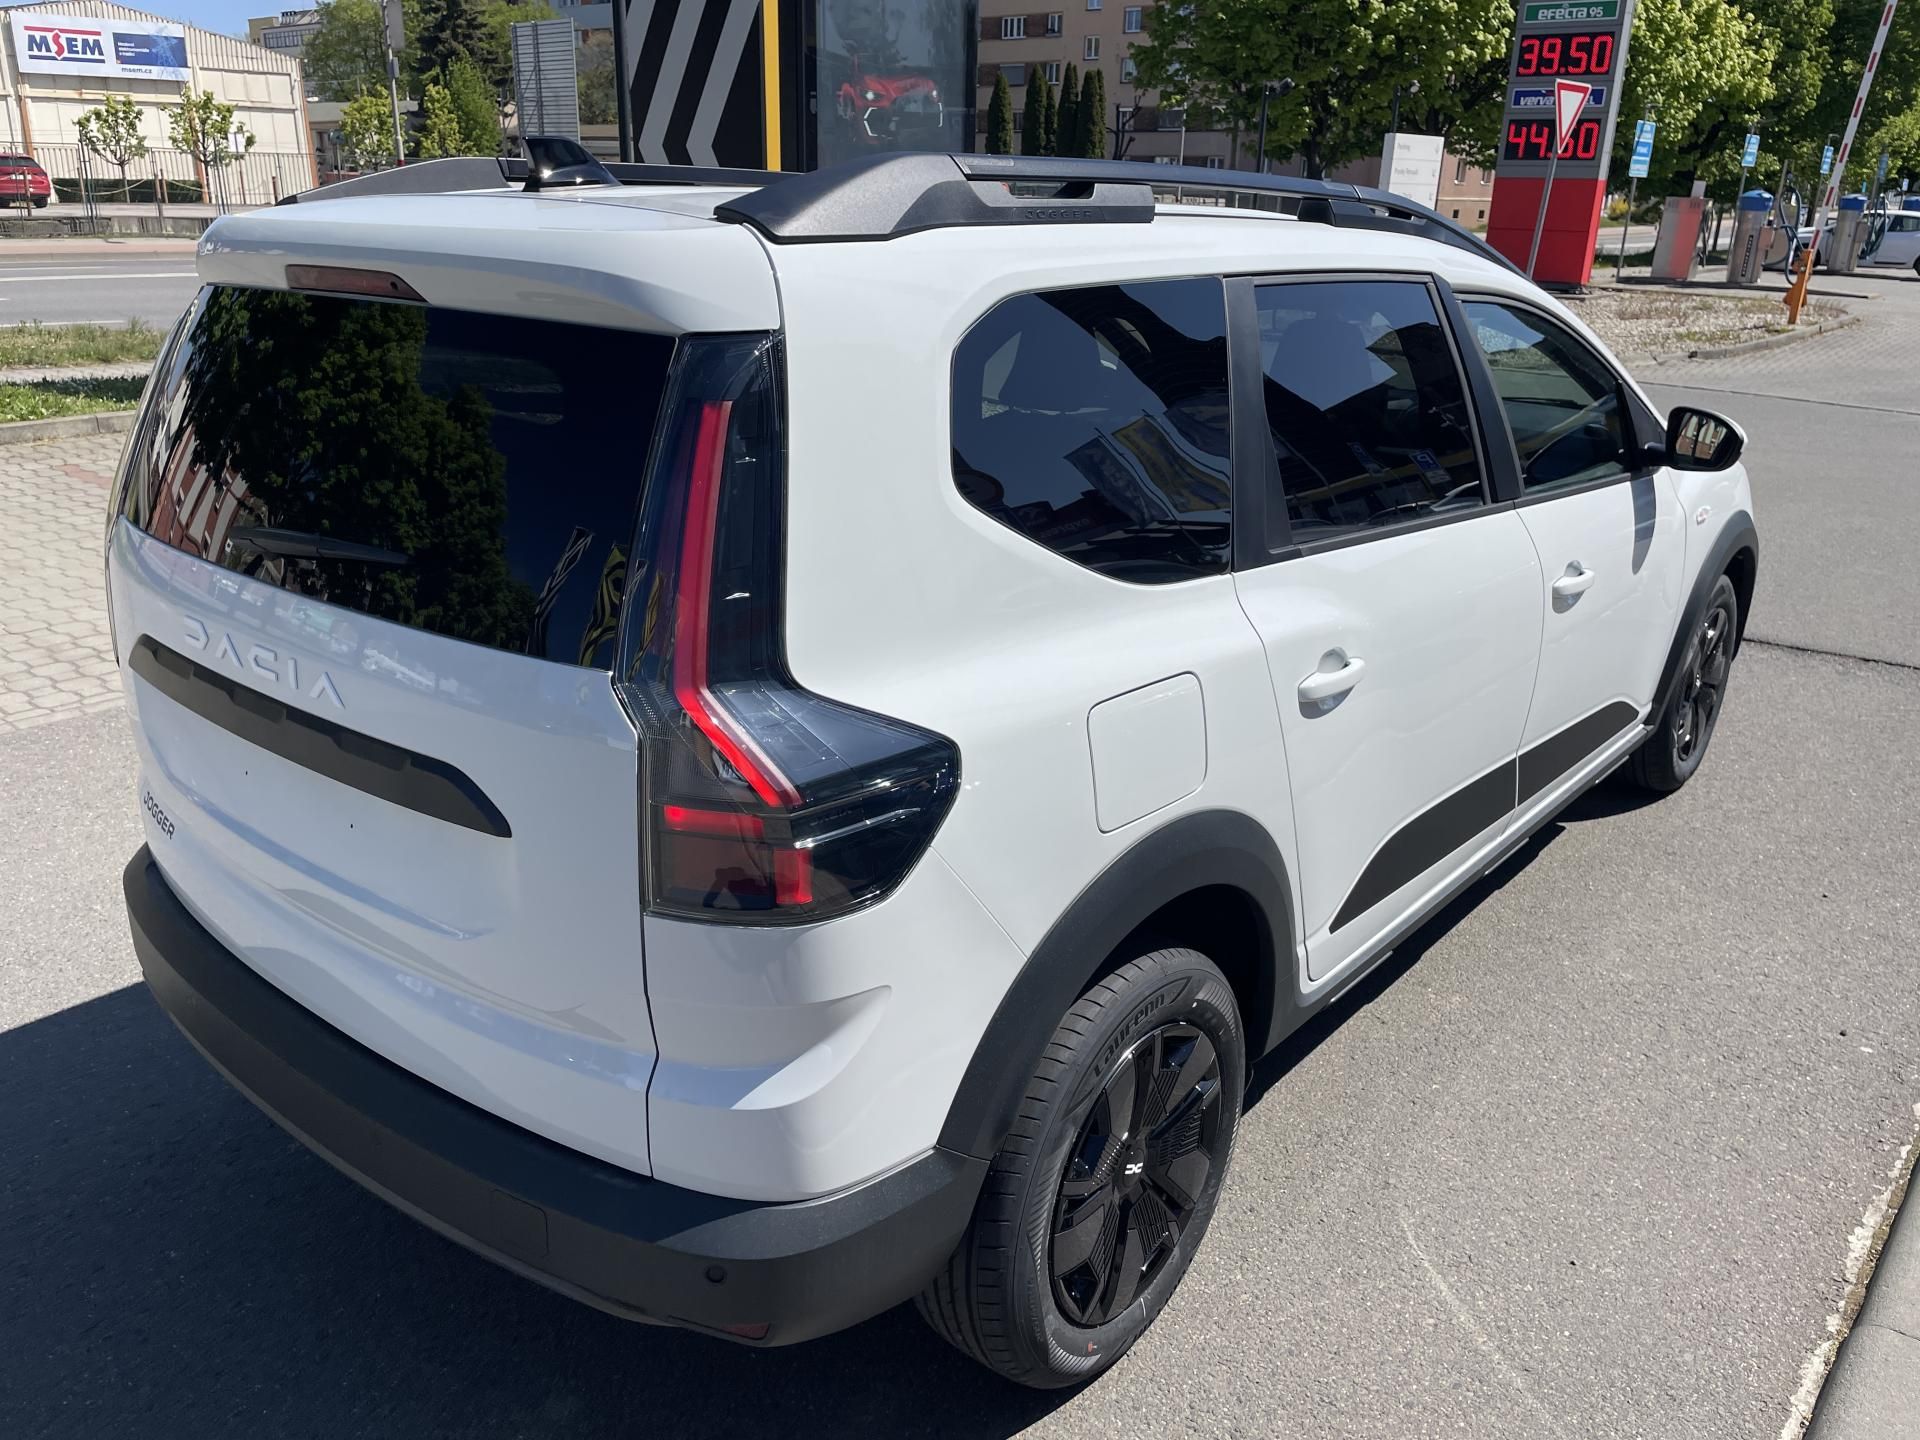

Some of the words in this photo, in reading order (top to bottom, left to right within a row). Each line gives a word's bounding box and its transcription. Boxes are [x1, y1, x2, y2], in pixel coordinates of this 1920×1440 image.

[1589, 6, 1604, 18] 95
[28, 32, 104, 58] MSEM
[1518, 35, 1613, 75] 39.50
[183, 614, 346, 709] DACIA
[143, 791, 176, 840] JOGGER
[1094, 993, 1166, 1077] Laurenn
